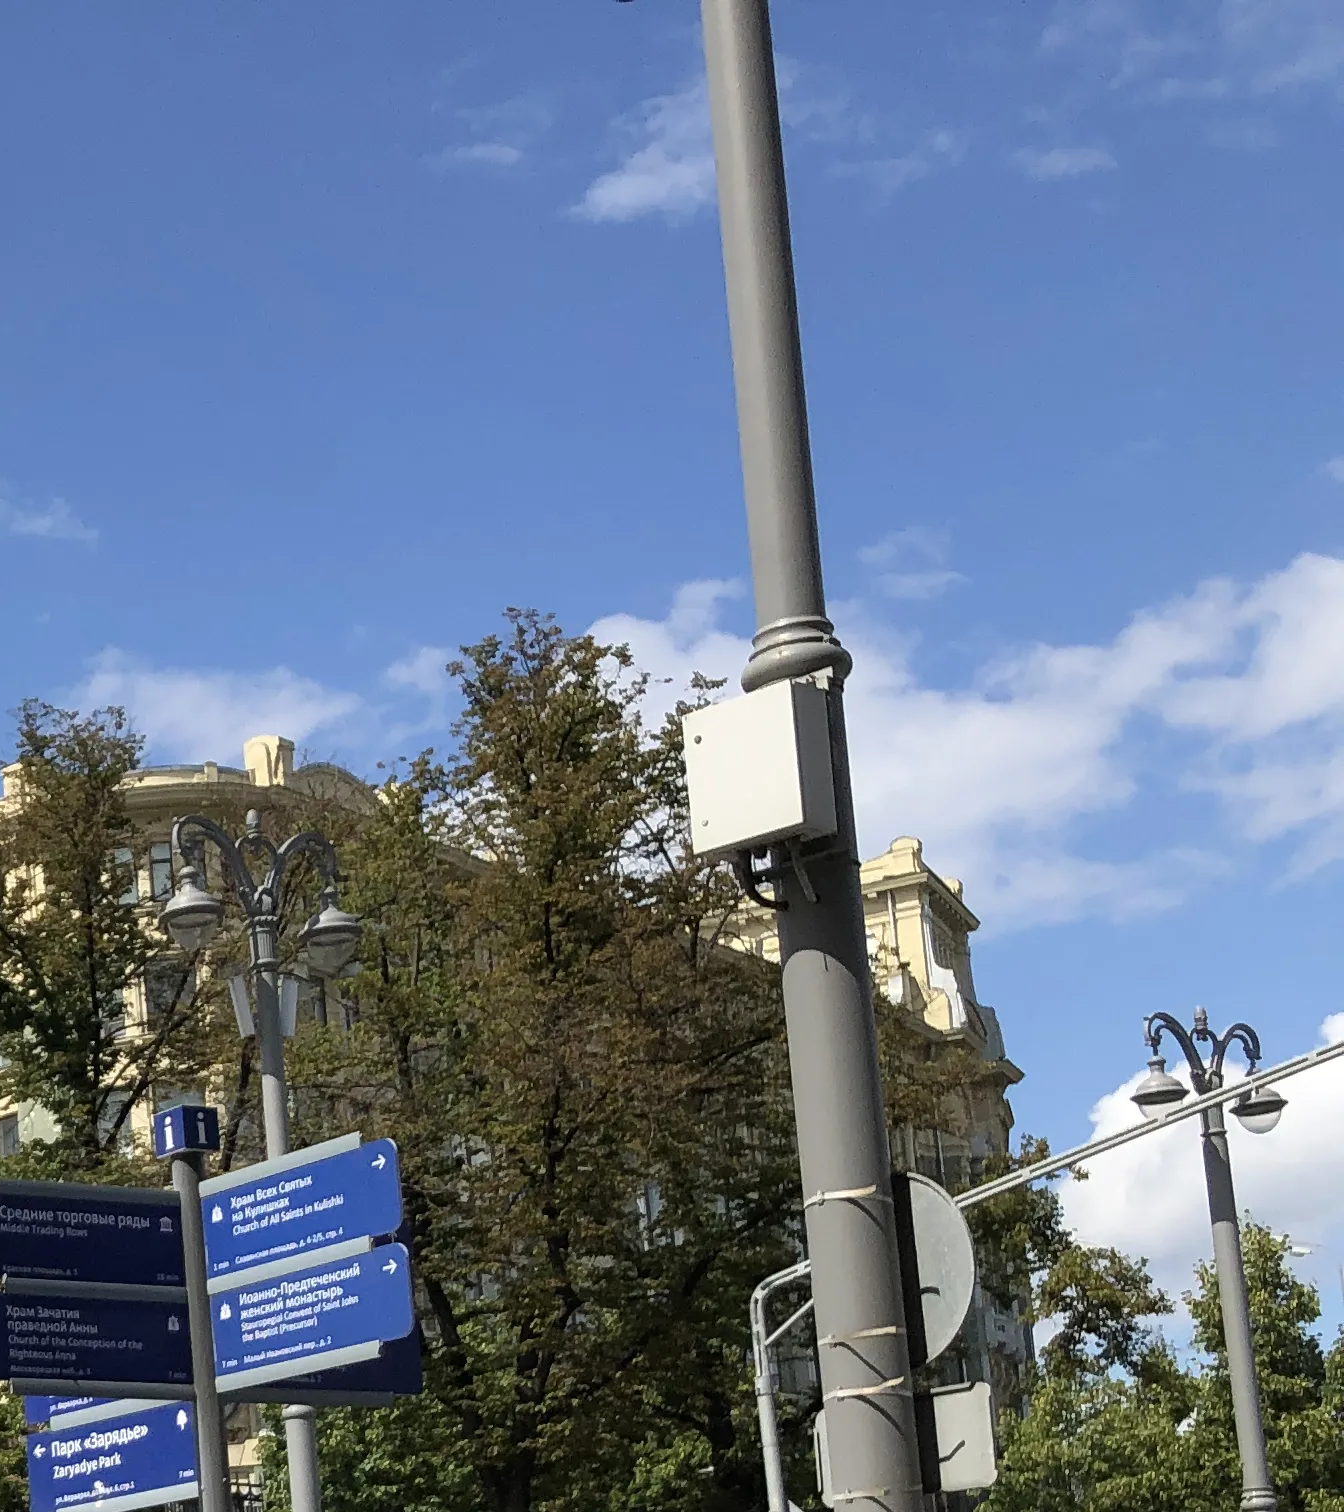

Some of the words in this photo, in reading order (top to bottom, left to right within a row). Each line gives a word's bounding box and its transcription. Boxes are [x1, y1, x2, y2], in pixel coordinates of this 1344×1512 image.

[230, 1194, 255, 1210] Храм
[256, 1186, 277, 1200] Всех
[278, 1176, 312, 1193] Святых
[0, 1205, 54, 1222] Средние
[56, 1211, 115, 1227] торговые
[117, 1215, 150, 1229] ряды
[232, 1212, 244, 1223] на
[245, 1197, 290, 1217] Кулишках
[232, 1218, 259, 1236] Church
[260, 1215, 269, 1228] of
[269, 1212, 280, 1225] All
[281, 1205, 304, 1221] Saints
[304, 1203, 313, 1215] in
[314, 1194, 344, 1212] Kulishki
[0, 1223, 30, 1234] Middle
[32, 1225, 64, 1238] Trading
[66, 1227, 88, 1237] Rows
[218, 1260, 230, 1270] min
[239, 1262, 360, 1307] Иоанно-Предтеченский
[6, 1305, 35, 1318] Храм
[37, 1306, 80, 1319] Зачатия
[240, 1300, 283, 1320] женский
[285, 1285, 343, 1309] монастырь
[284, 1306, 312, 1321] Convent
[313, 1302, 321, 1314] of
[322, 1299, 341, 1312] Saint
[341, 1295, 359, 1308] John
[7, 1320, 67, 1333] праведной
[69, 1323, 98, 1335] Анны
[242, 1332, 254, 1343] the
[255, 1325, 278, 1341] Baptist
[279, 1317, 318, 1338] (Precursor)
[8, 1335, 39, 1345] Church
[41, 1336, 50, 1345] of
[52, 1336, 66, 1346] the
[68, 1337, 115, 1350] Conception
[118, 1340, 127, 1349] of
[128, 1341, 142, 1350] the
[9, 1349, 53, 1361] Righteous
[55, 1351, 76, 1361] Anna
[51, 1439, 82, 1459] Парк
[84, 1425, 149, 1450] «Зарядье»
[52, 1457, 98, 1480] Zaryadye
[99, 1452, 121, 1469] Park
[183, 1469, 194, 1478] min
